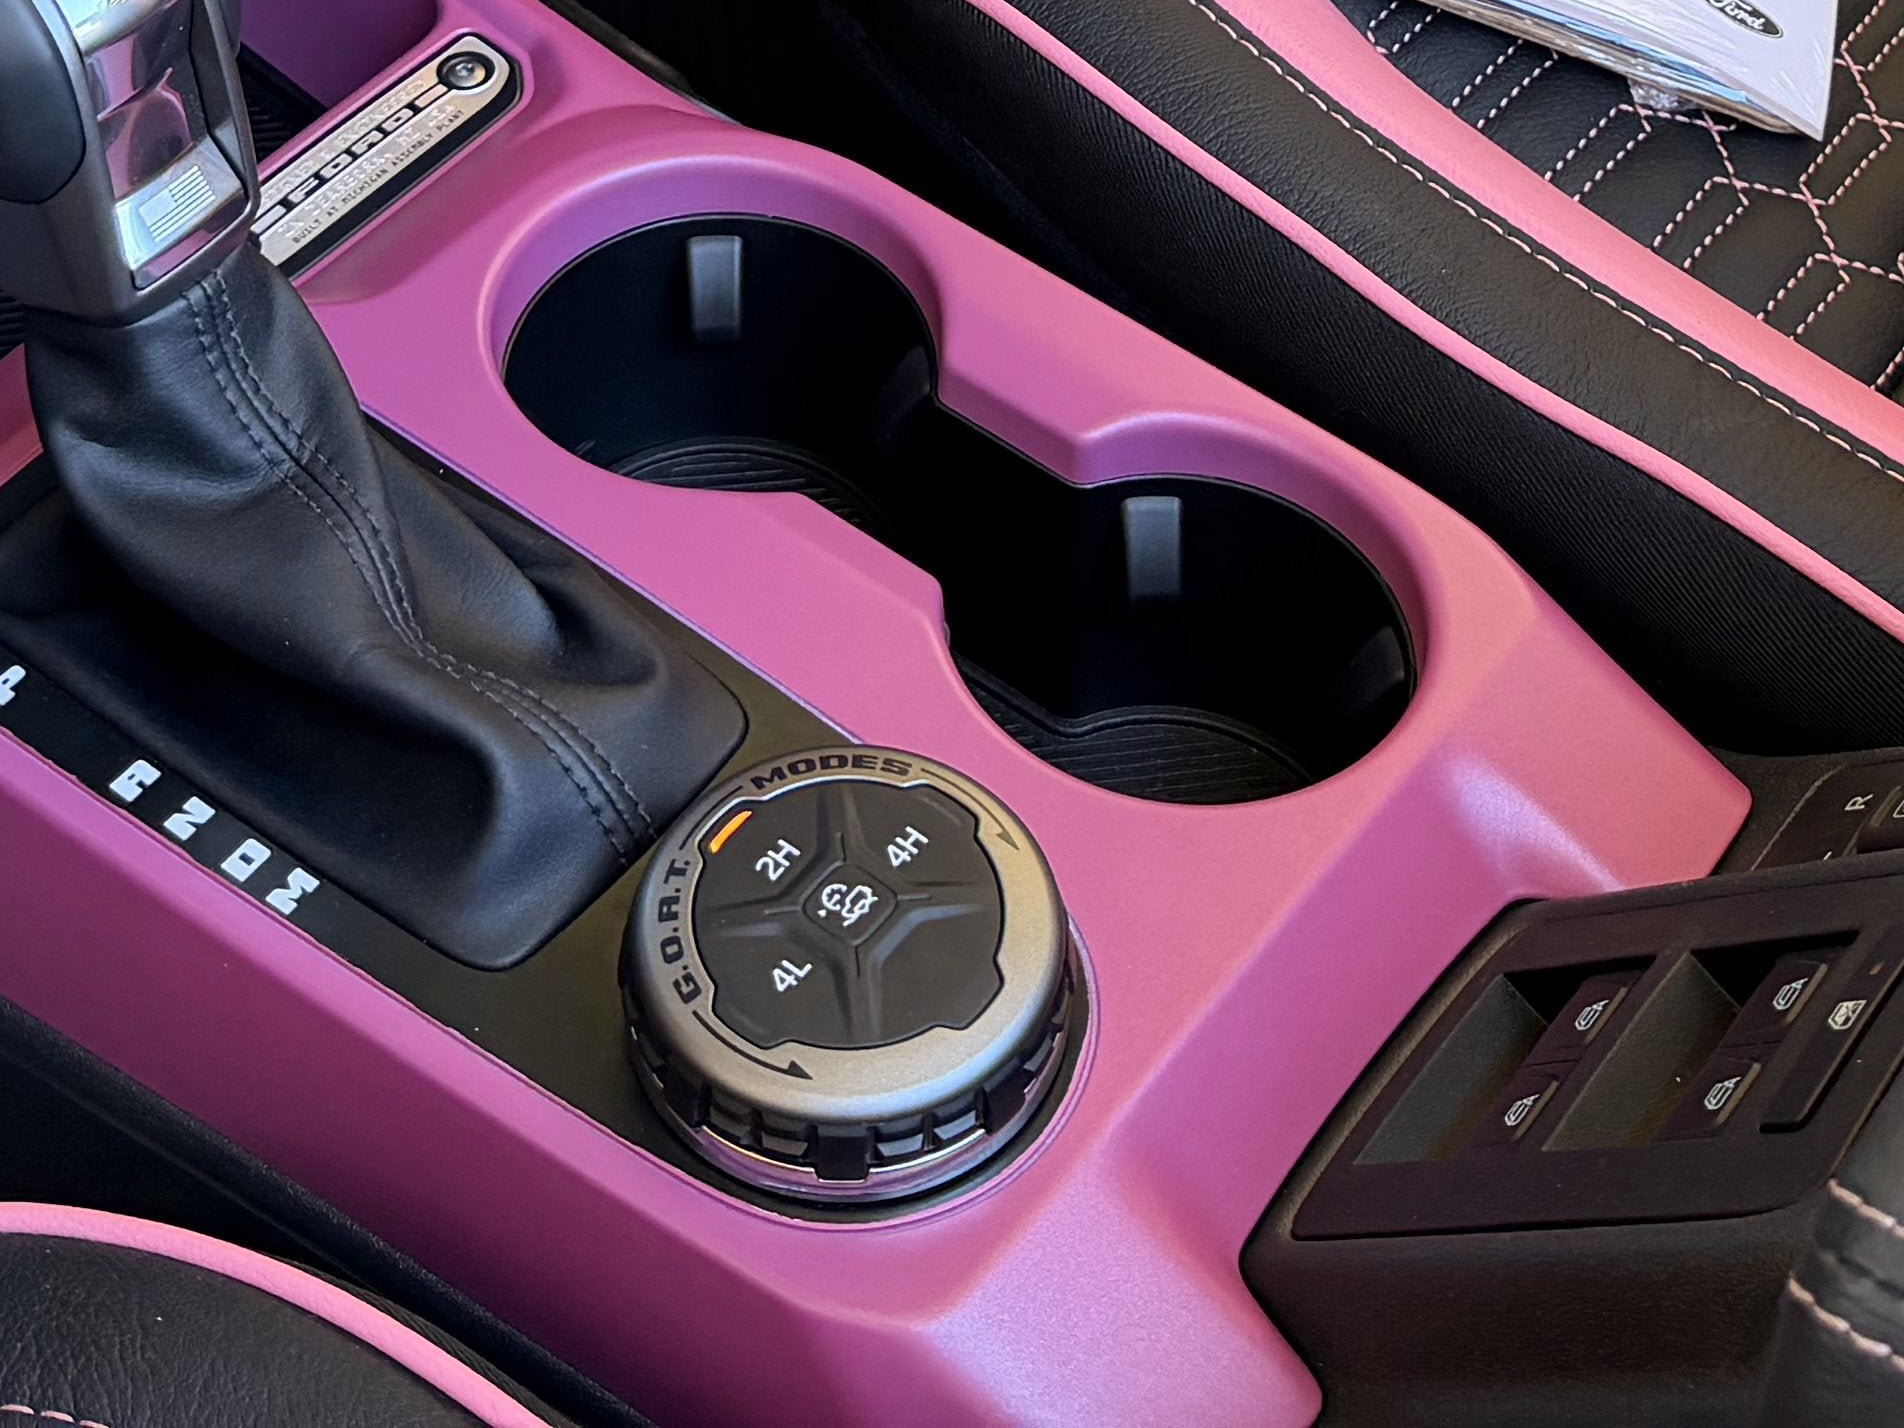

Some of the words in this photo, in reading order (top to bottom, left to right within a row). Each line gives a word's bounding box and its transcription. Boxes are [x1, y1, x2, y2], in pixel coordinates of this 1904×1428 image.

[287, 108, 414, 204] FORD
[292, 220, 322, 243] BUILT
[327, 207, 338, 217] AT
[341, 169, 388, 204] MICHIGAN
[392, 133, 434, 166] ASSEMBLY
[436, 110, 464, 131] PLANT
[751, 753, 913, 790] MODES
[1844, 794, 1873, 811] R
[109, 759, 161, 802] R
[163, 797, 216, 841] N
[221, 838, 271, 881] D
[266, 867, 320, 915] M
[886, 826, 929, 869] 4H
[755, 839, 801, 882] 2H
[772, 960, 812, 993] 4L
